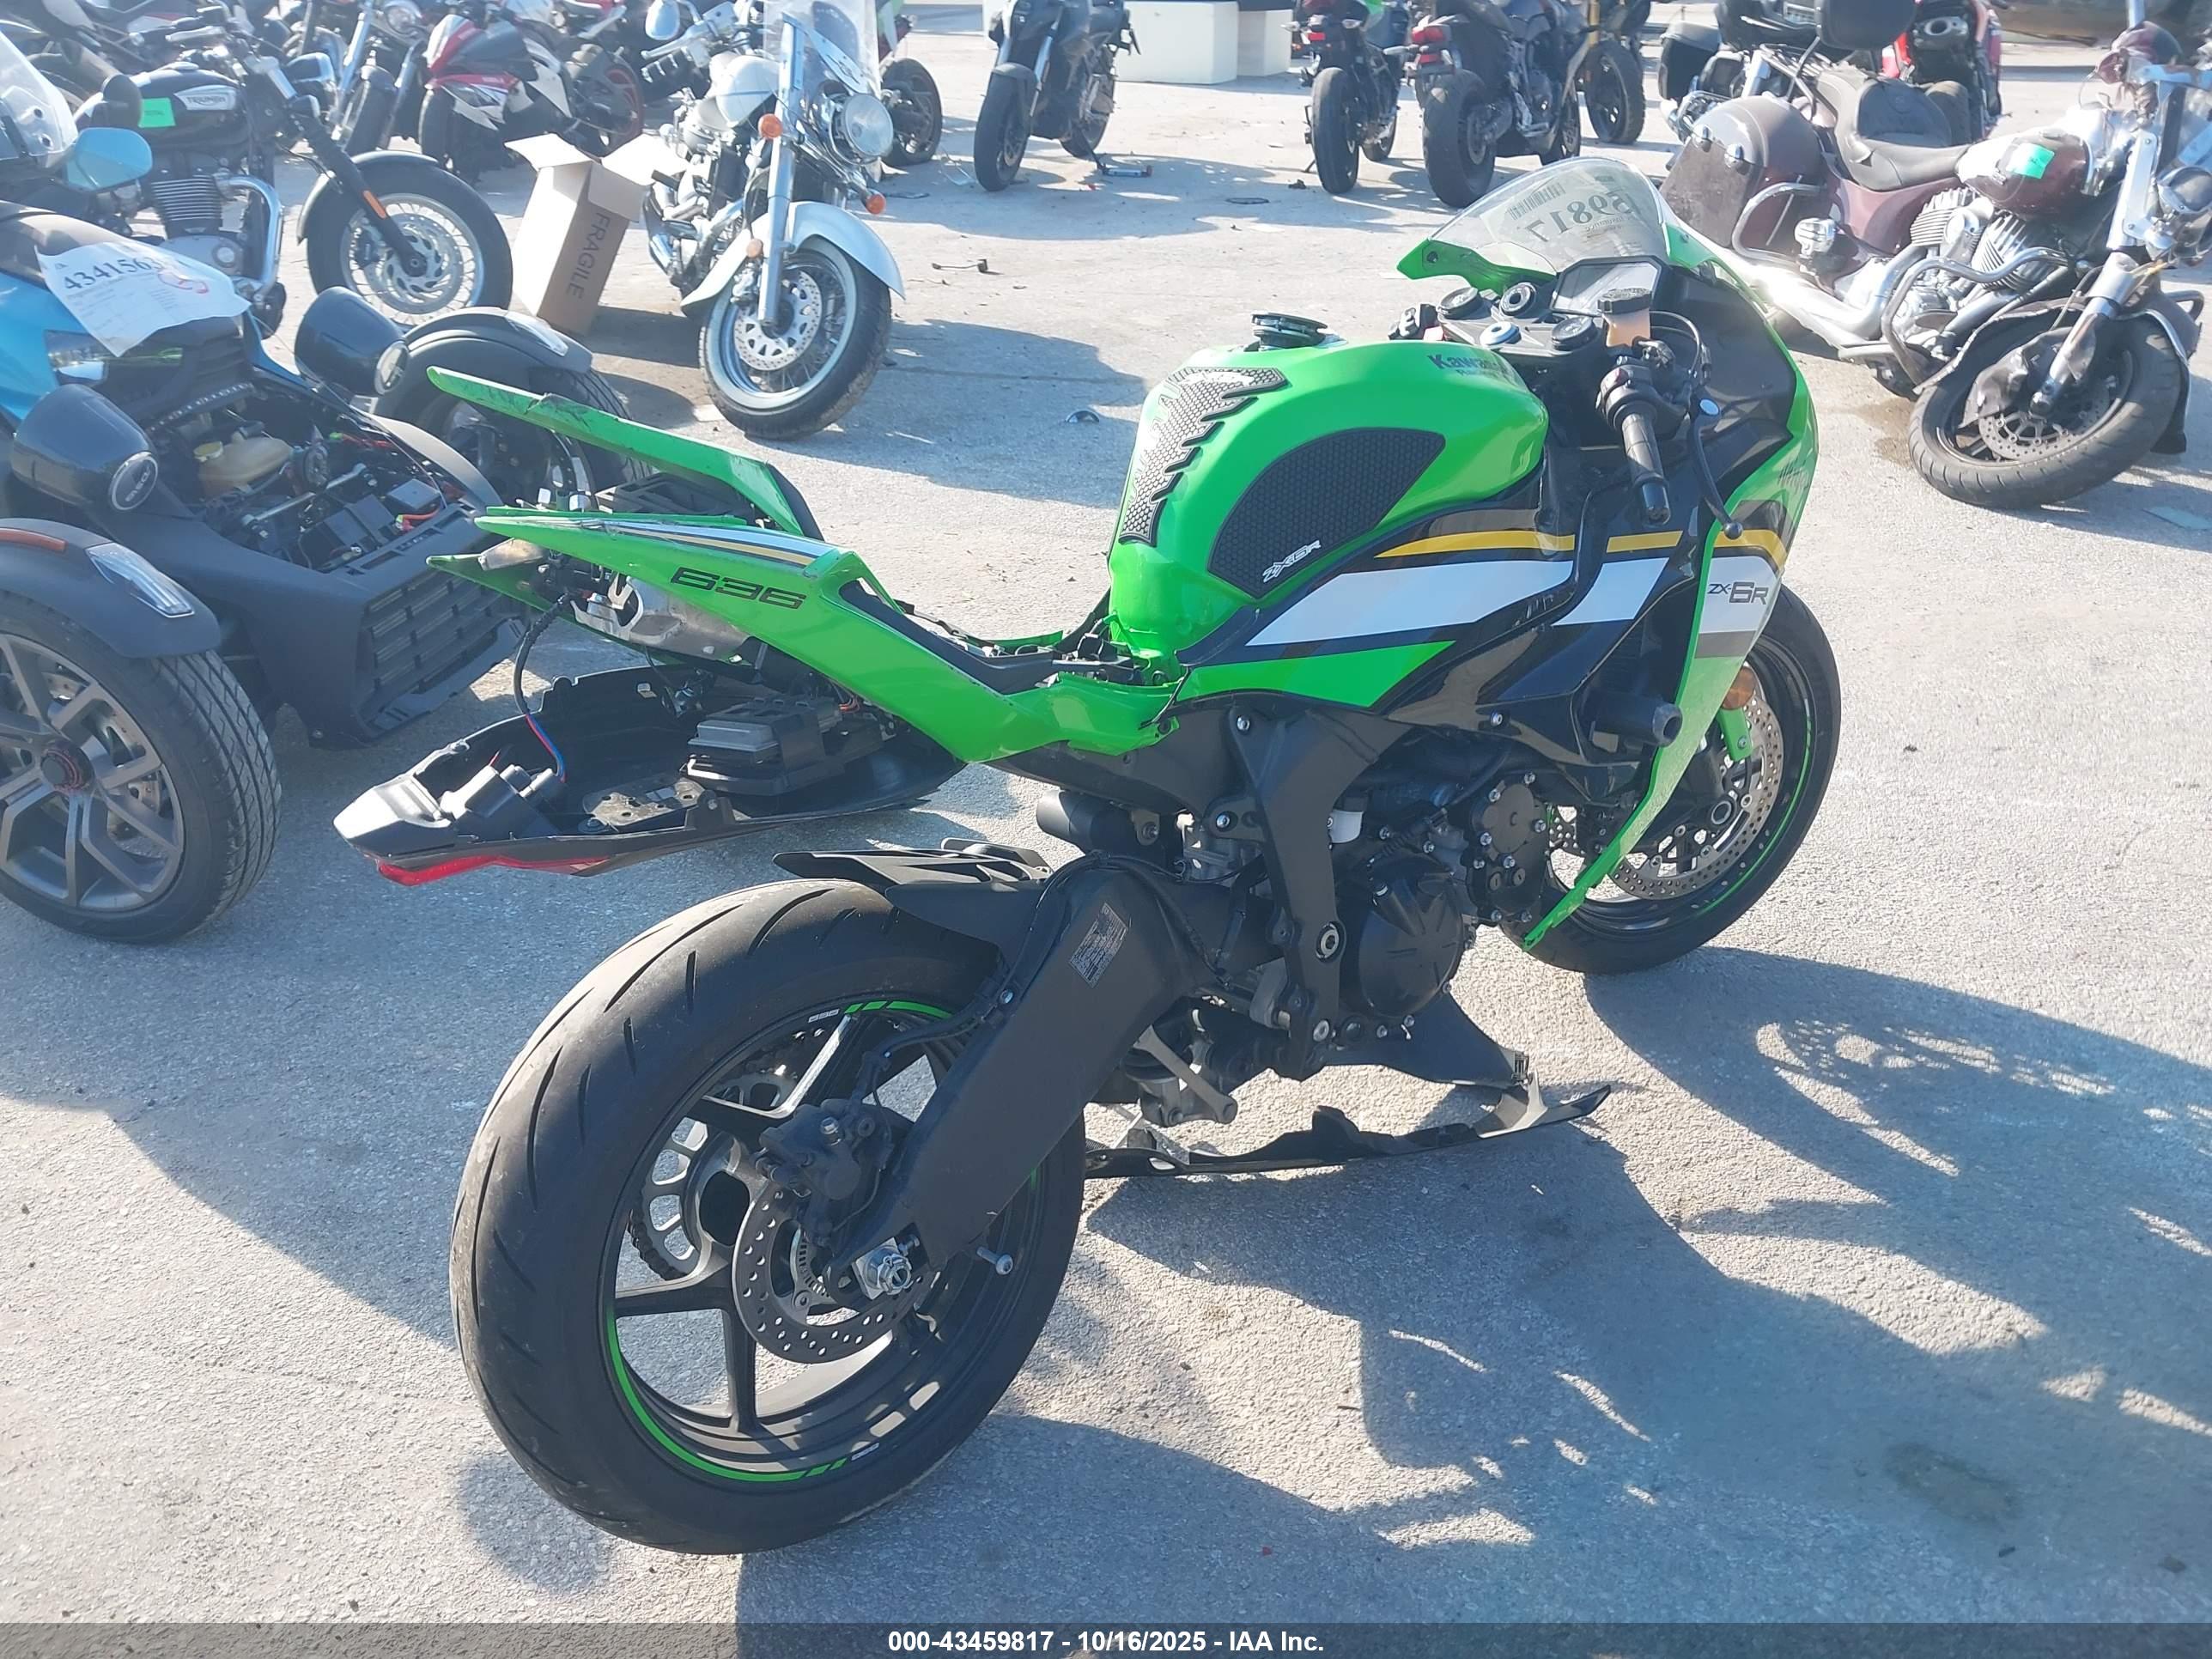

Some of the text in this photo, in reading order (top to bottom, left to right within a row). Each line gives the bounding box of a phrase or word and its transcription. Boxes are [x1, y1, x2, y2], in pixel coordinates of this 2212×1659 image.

[565, 212, 611, 299] FRAGILE
[670, 566, 808, 610] 636
[1707, 581, 1769, 605] ZX-6R
